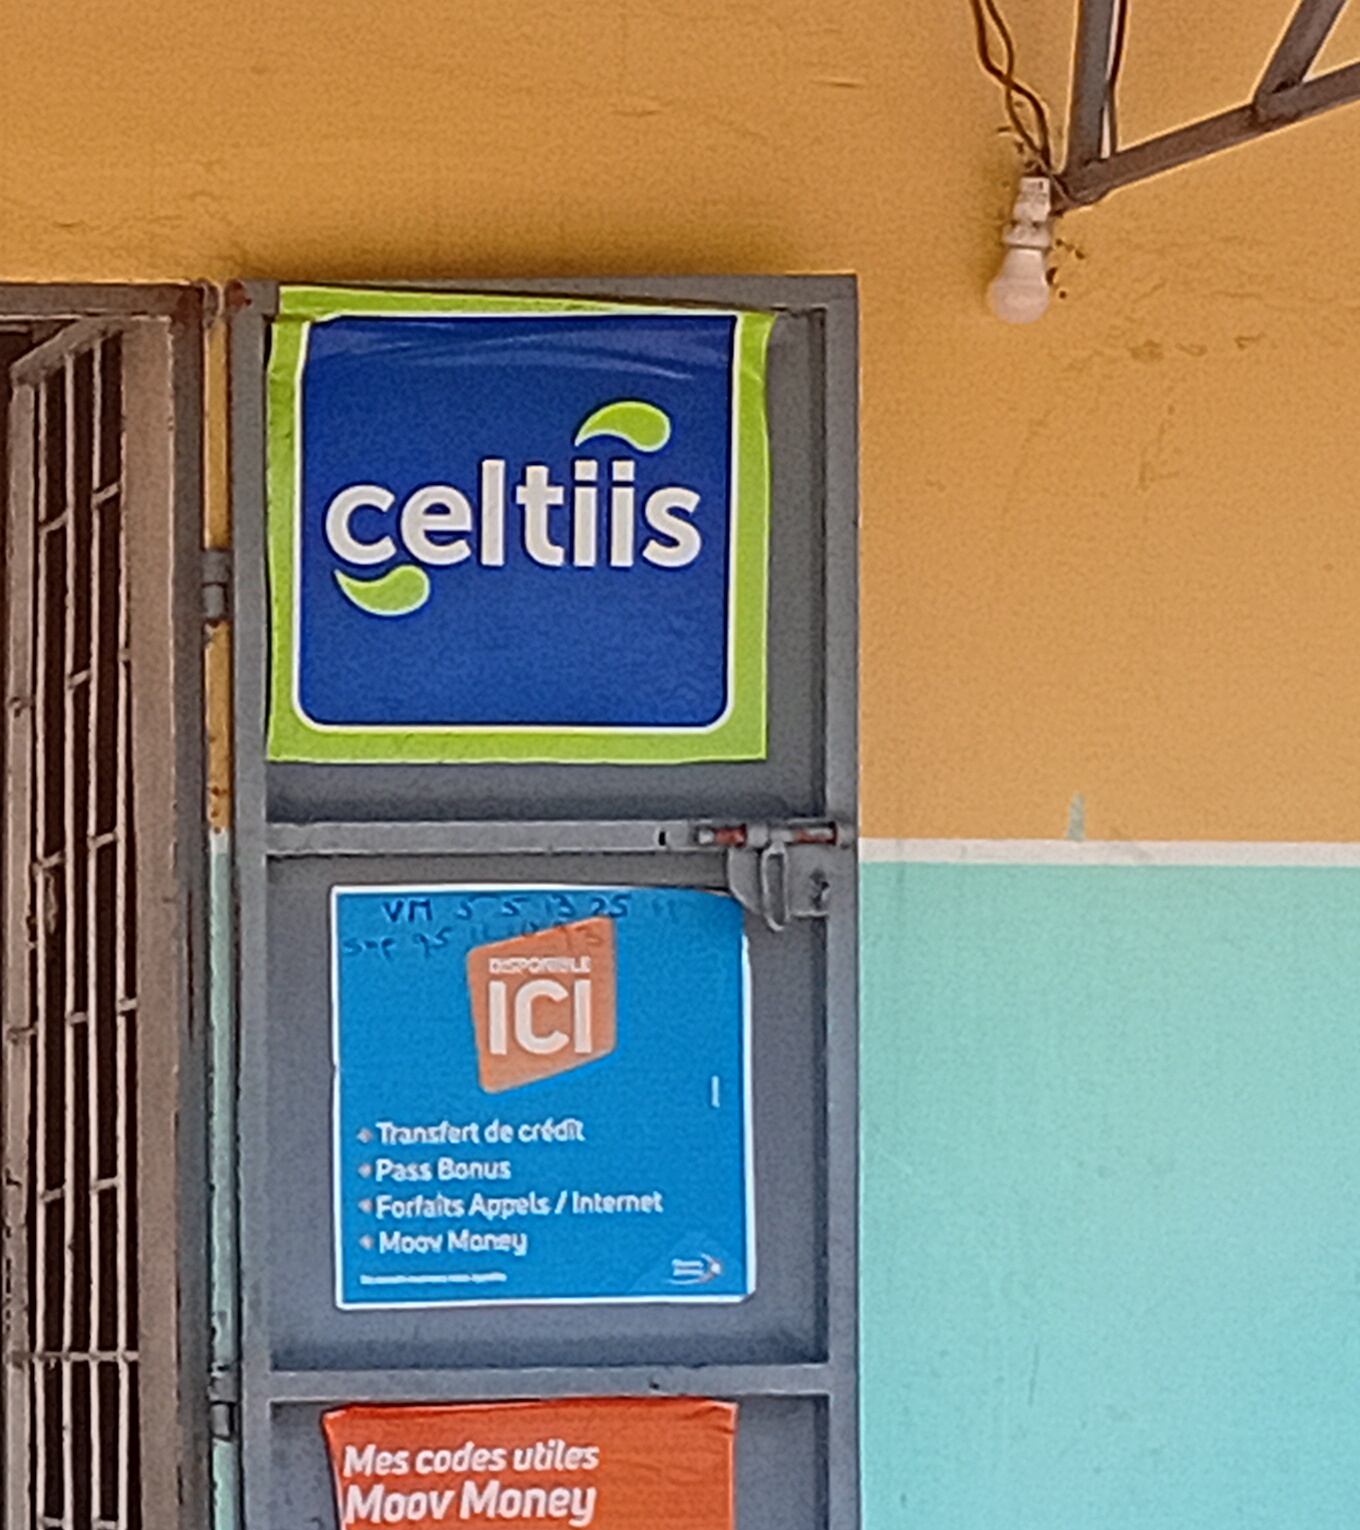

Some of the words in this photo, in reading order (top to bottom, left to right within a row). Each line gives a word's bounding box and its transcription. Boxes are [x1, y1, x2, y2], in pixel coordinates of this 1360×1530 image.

[325, 457, 703, 568] celtiis
[488, 977, 592, 1056] ICI
[375, 1119, 480, 1146] Transfert
[483, 1118, 514, 1143] de
[517, 1117, 586, 1143] crédit
[375, 1158, 432, 1182] Pass
[437, 1157, 512, 1181] Bonus
[375, 1193, 465, 1219] Forfaits
[467, 1190, 551, 1220] Appels
[554, 1189, 568, 1214] /
[571, 1190, 664, 1214] Internet
[379, 1230, 444, 1254] Moov
[446, 1228, 528, 1256] Money
[342, 1443, 411, 1478] Mes
[415, 1440, 508, 1475] codes
[512, 1438, 601, 1472] utiles
[344, 1482, 456, 1524] Moov
[459, 1479, 598, 1528] Money
